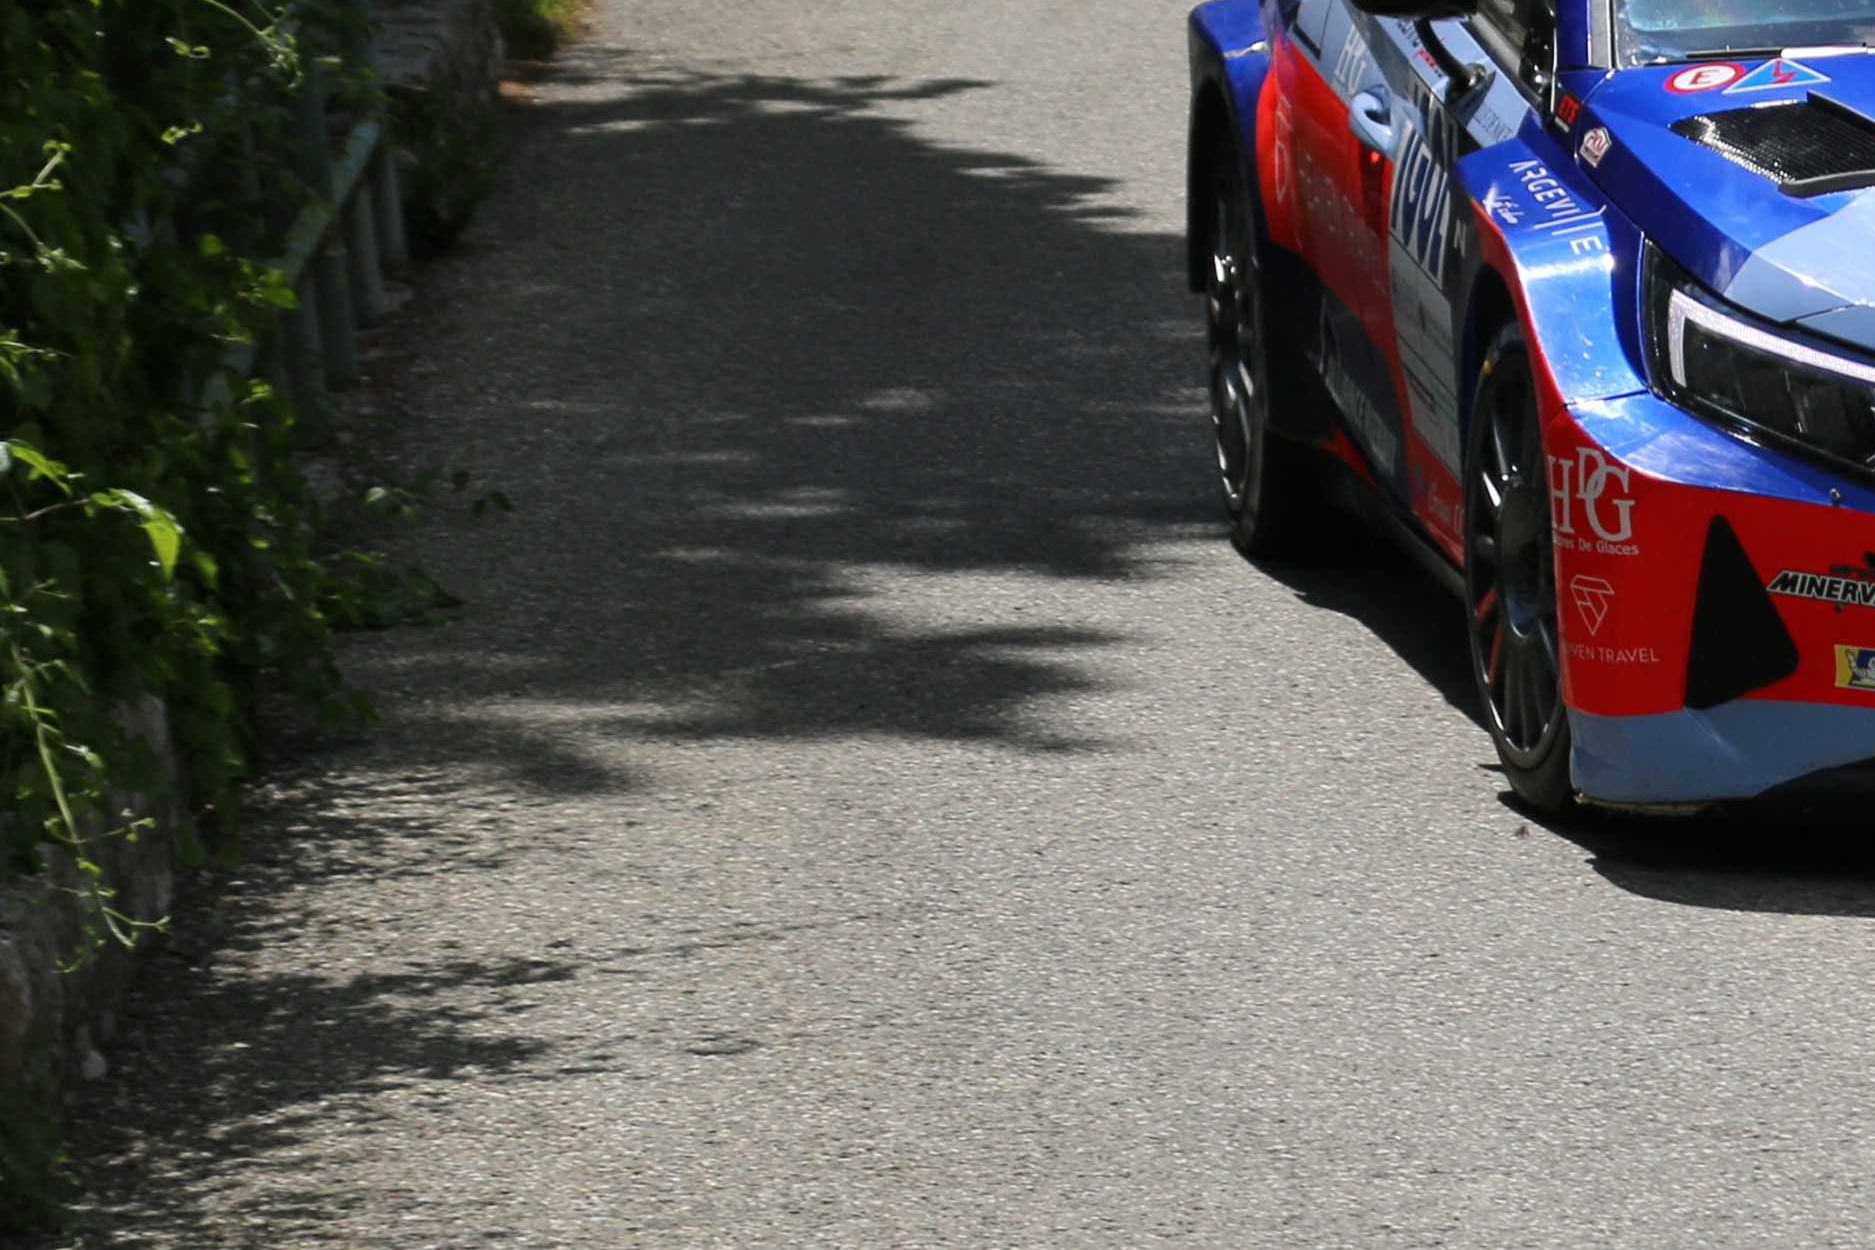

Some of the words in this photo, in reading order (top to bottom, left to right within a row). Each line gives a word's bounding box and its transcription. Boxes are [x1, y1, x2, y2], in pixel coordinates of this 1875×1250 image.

[1688, 68, 1720, 85] E
[1596, 539, 1640, 555] Glaces
[1598, 645, 1660, 663] TRAVEL
